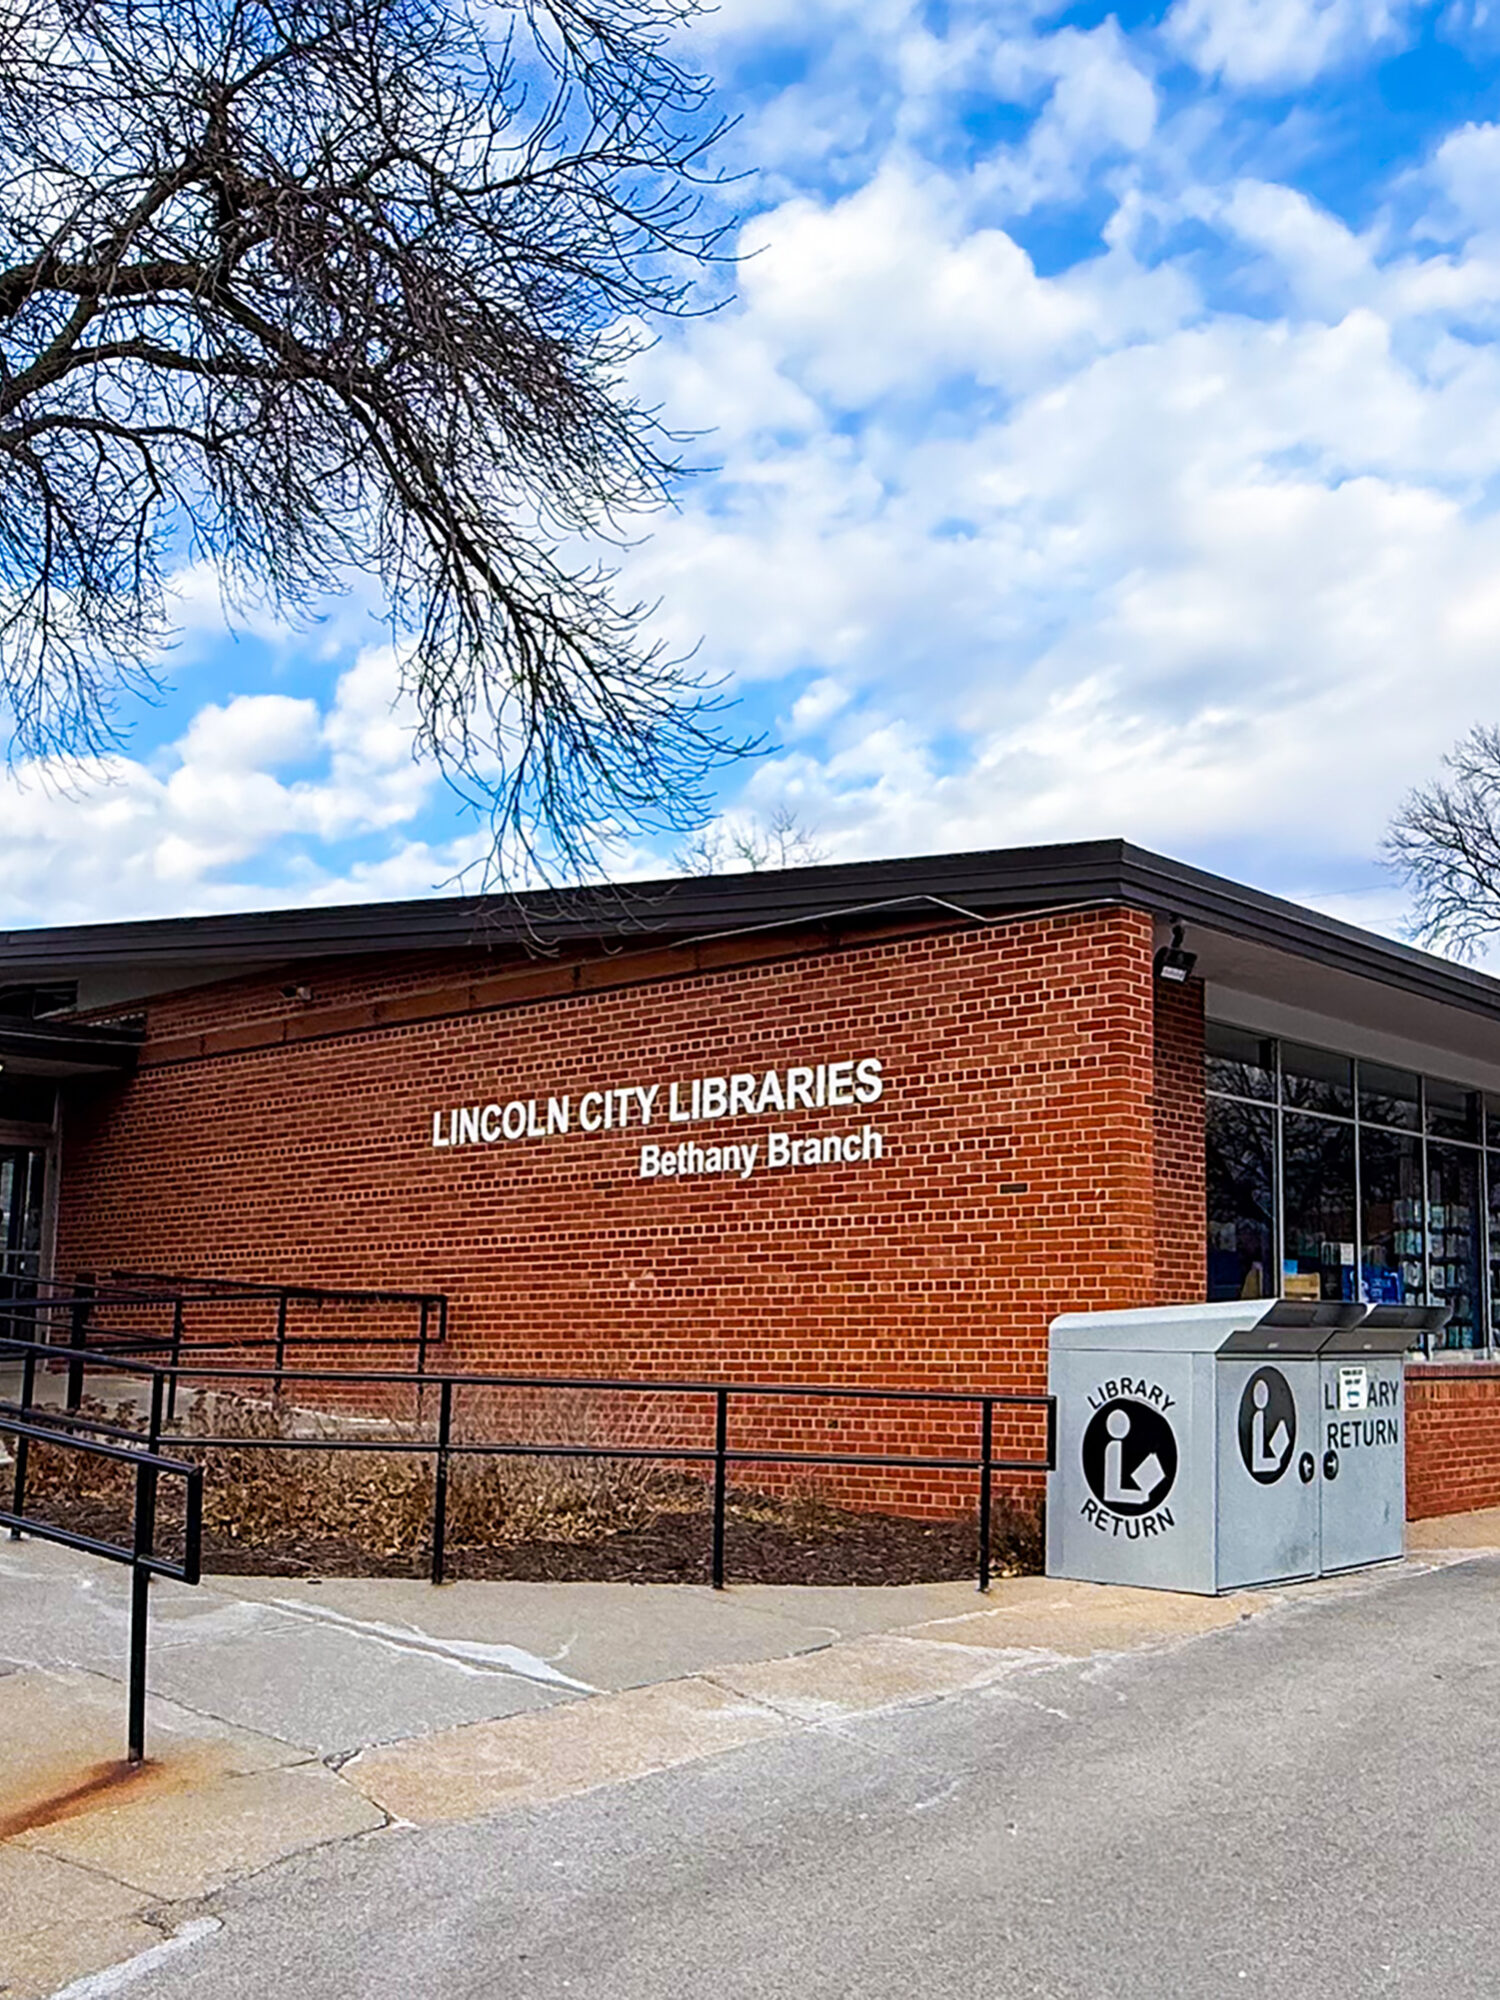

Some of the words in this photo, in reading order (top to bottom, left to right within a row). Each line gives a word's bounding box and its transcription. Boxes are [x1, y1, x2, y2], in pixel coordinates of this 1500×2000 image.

[432, 1095, 570, 1147] LINCOLN
[579, 1084, 660, 1131] CITY
[669, 1058, 883, 1122] LIBRARIES
[639, 1141, 759, 1179] Bethany
[767, 1125, 883, 1168] Branch
[1087, 1377, 1176, 1412] LIBRARY
[1324, 1380, 1399, 1410] LIARY
[1327, 1419, 1398, 1449] RETURN
[1080, 1498, 1175, 1540] RETURN
